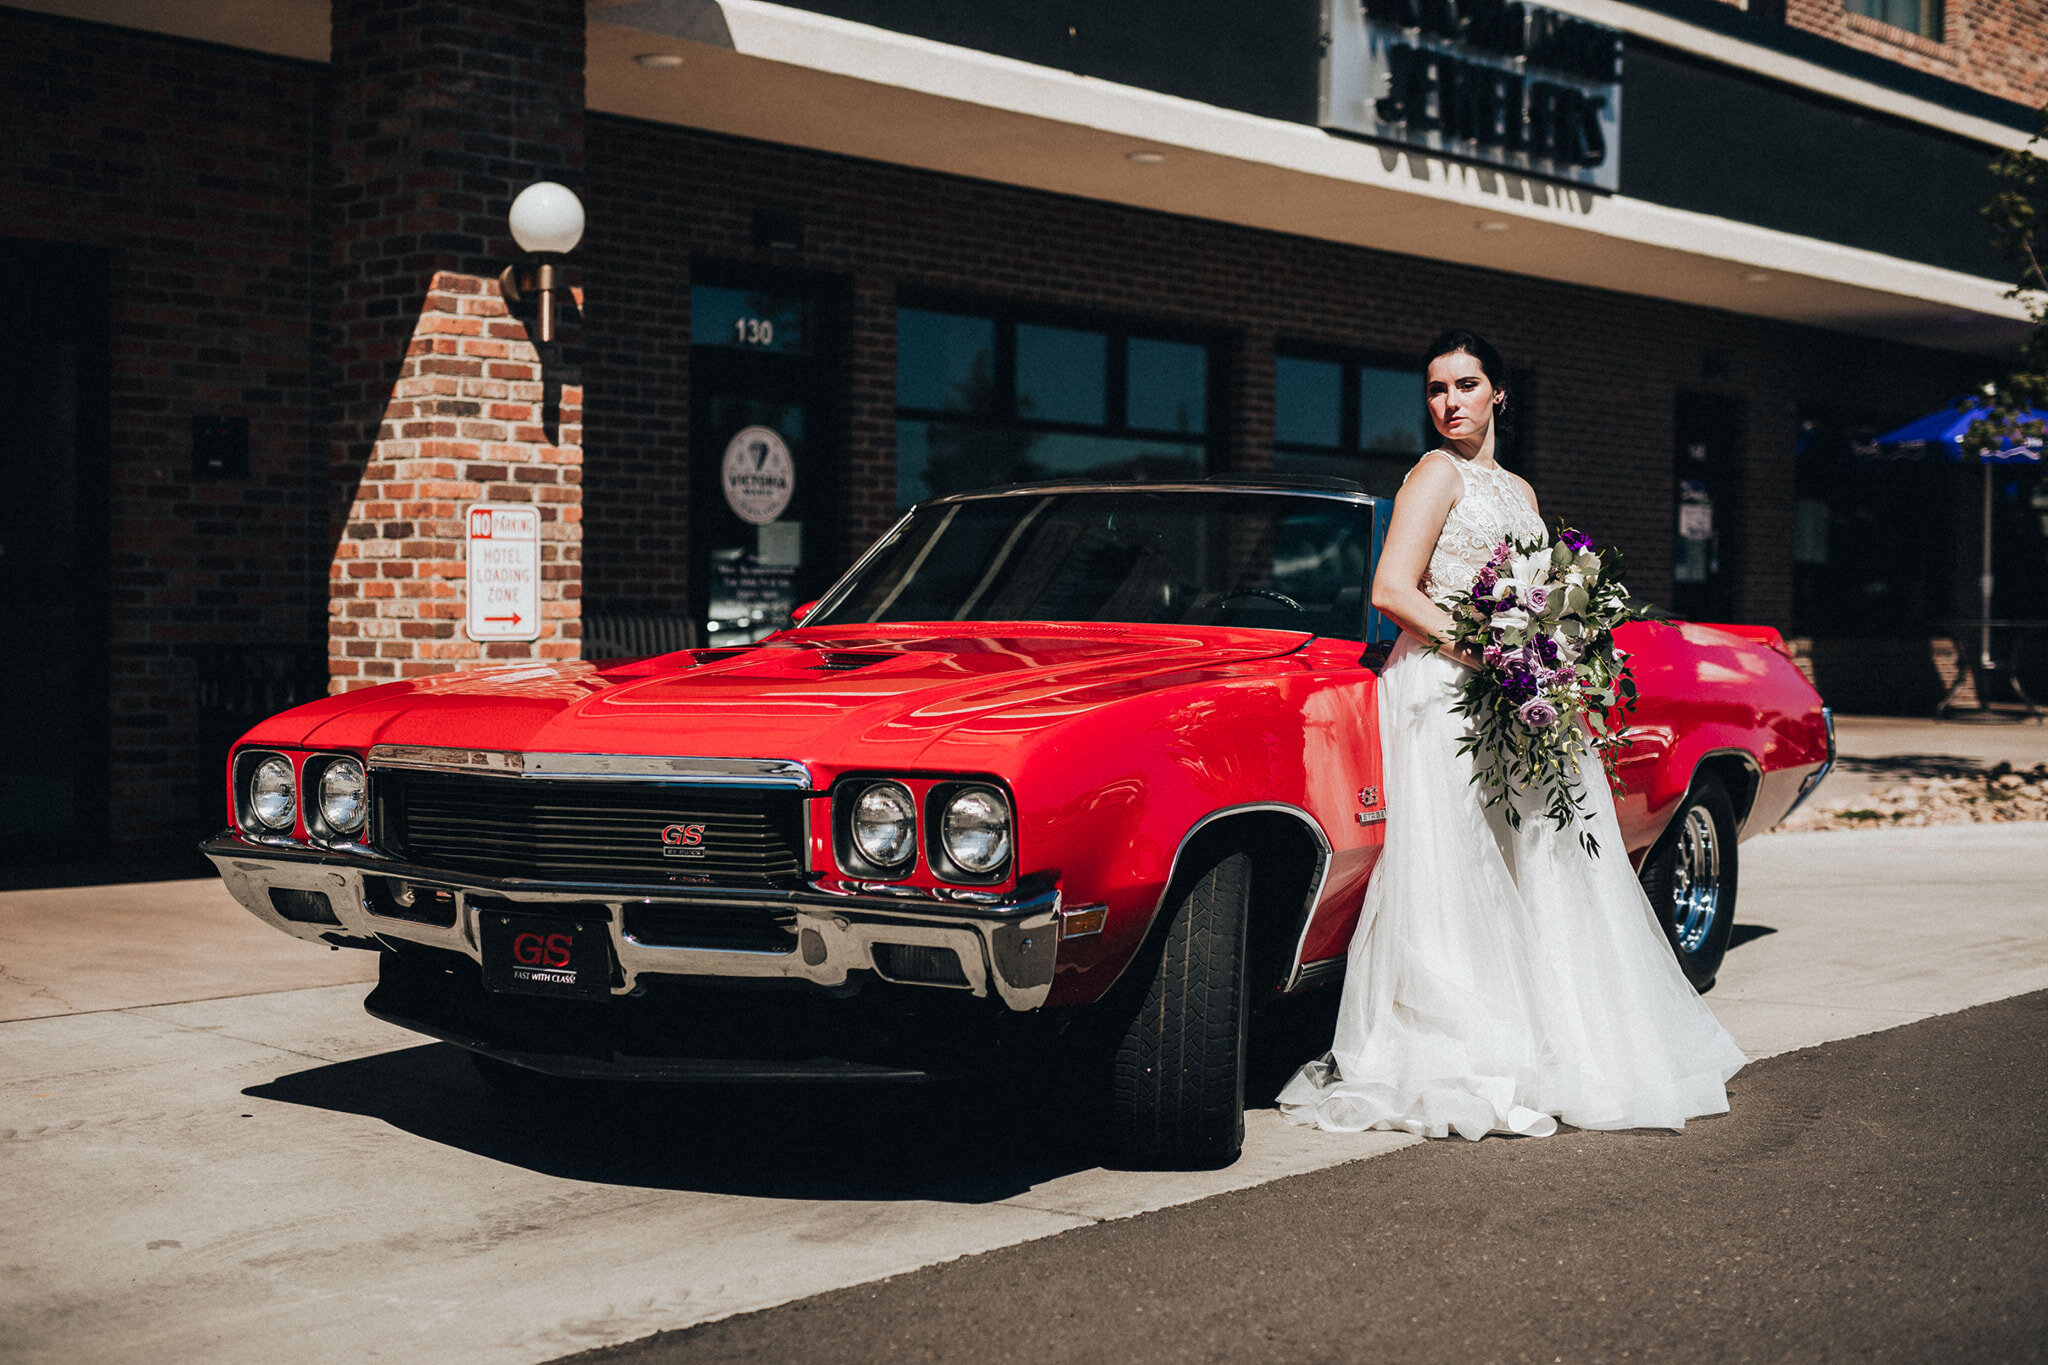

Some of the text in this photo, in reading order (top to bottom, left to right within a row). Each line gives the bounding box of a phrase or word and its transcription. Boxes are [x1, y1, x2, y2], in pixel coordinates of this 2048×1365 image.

[735, 317, 773, 345] 130
[728, 475, 787, 489] VICTORIA
[472, 512, 533, 537] NO PARKING
[484, 549, 523, 564] HOTEL
[476, 568, 530, 584] LOADING
[487, 587, 520, 603] ZONE
[661, 824, 706, 846] GS
[513, 933, 573, 967] GS
[514, 970, 530, 980] FAST
[531, 972, 551, 982] WITH
